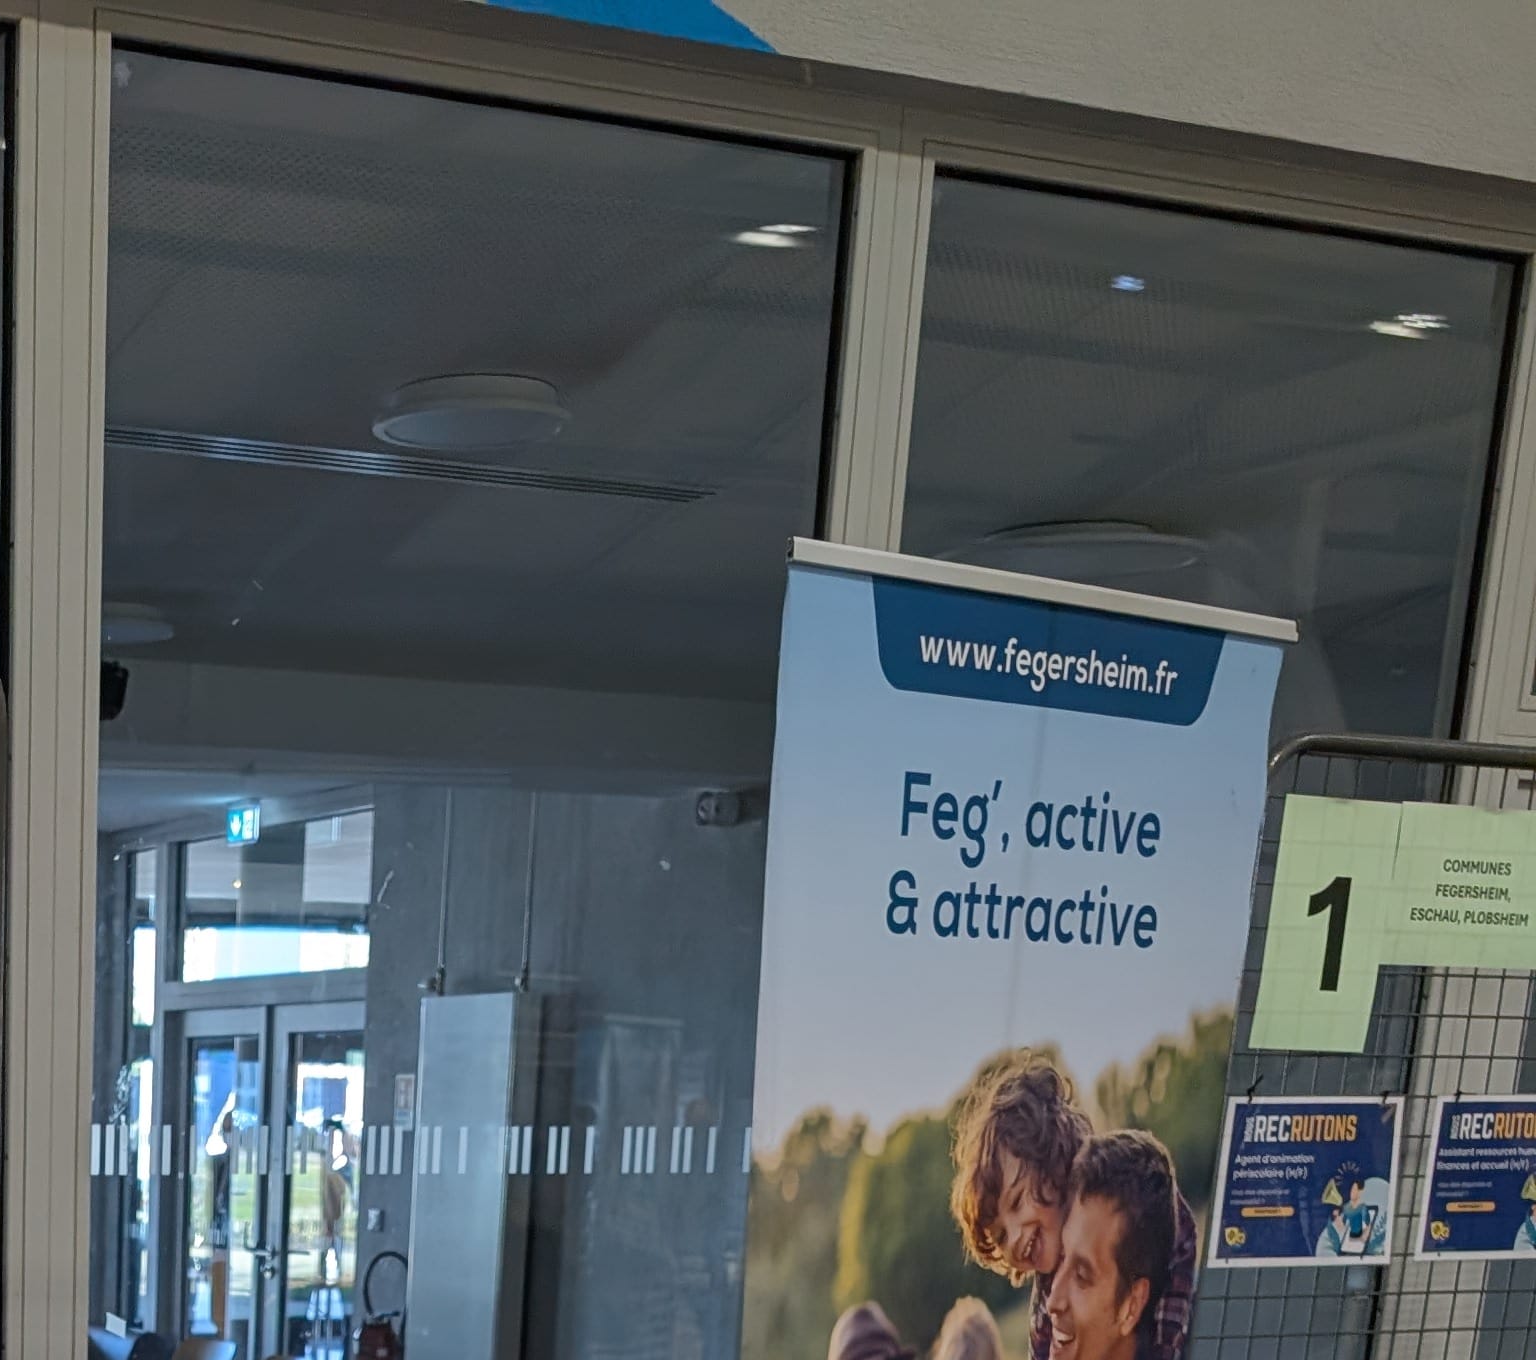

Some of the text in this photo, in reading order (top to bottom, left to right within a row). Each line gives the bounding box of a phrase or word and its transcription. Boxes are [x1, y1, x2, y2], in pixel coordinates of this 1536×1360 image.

[919, 633, 1178, 697] www.fegersheim.fr
[1025, 790, 1162, 858] active
[1442, 857, 1512, 877] COMMUNES
[885, 869, 1159, 949] & attractive
[1434, 883, 1512, 905] FEGERSHEIM,
[1409, 907, 1530, 928] ESCHAU, PLOBSHEIM
[1306, 876, 1353, 992] 1
[1253, 1114, 1358, 1143] RECRUTONS
[1459, 1111, 1536, 1141] RECRUTO
